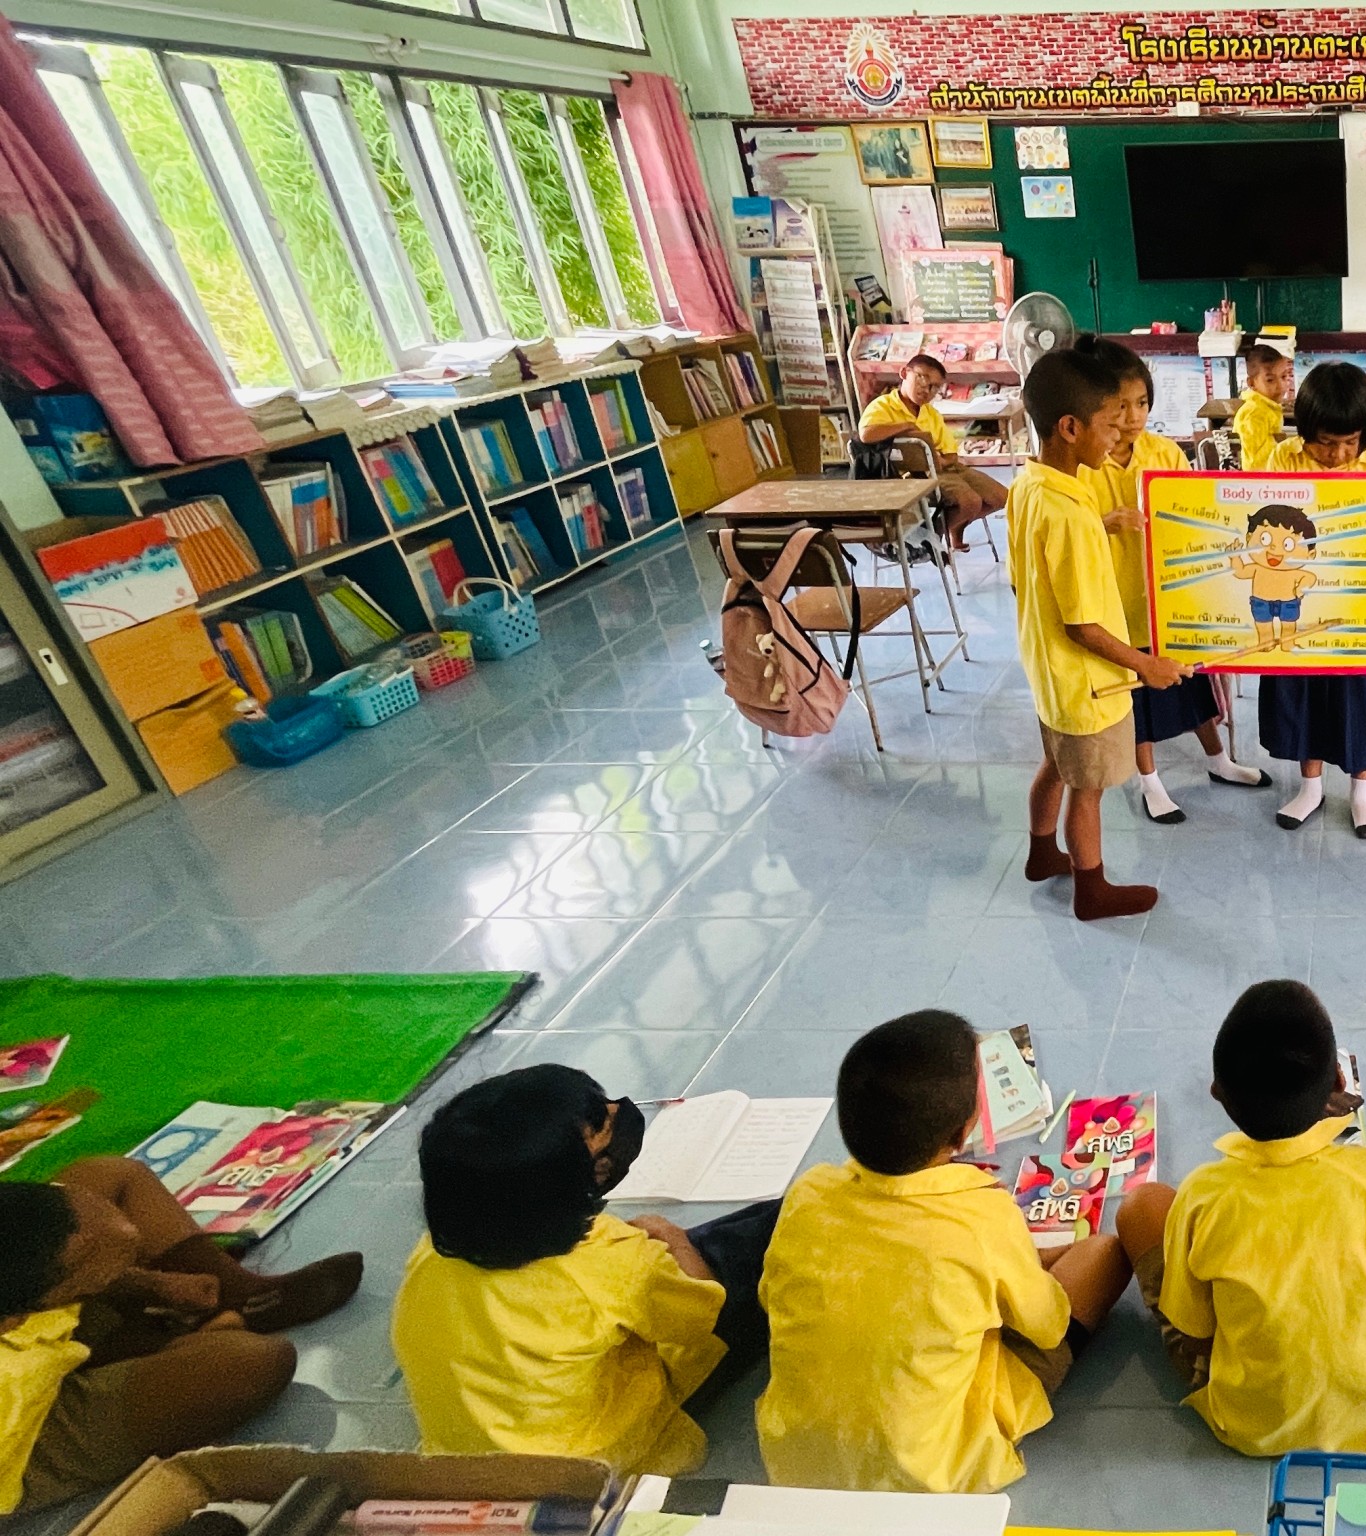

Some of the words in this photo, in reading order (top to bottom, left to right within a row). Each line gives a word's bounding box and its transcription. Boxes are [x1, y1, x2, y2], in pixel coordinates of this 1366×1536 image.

[1222, 487, 1252, 501] Body
[1258, 484, 1311, 500] (ร่างกาย)
[1318, 525, 1335, 536] Eye
